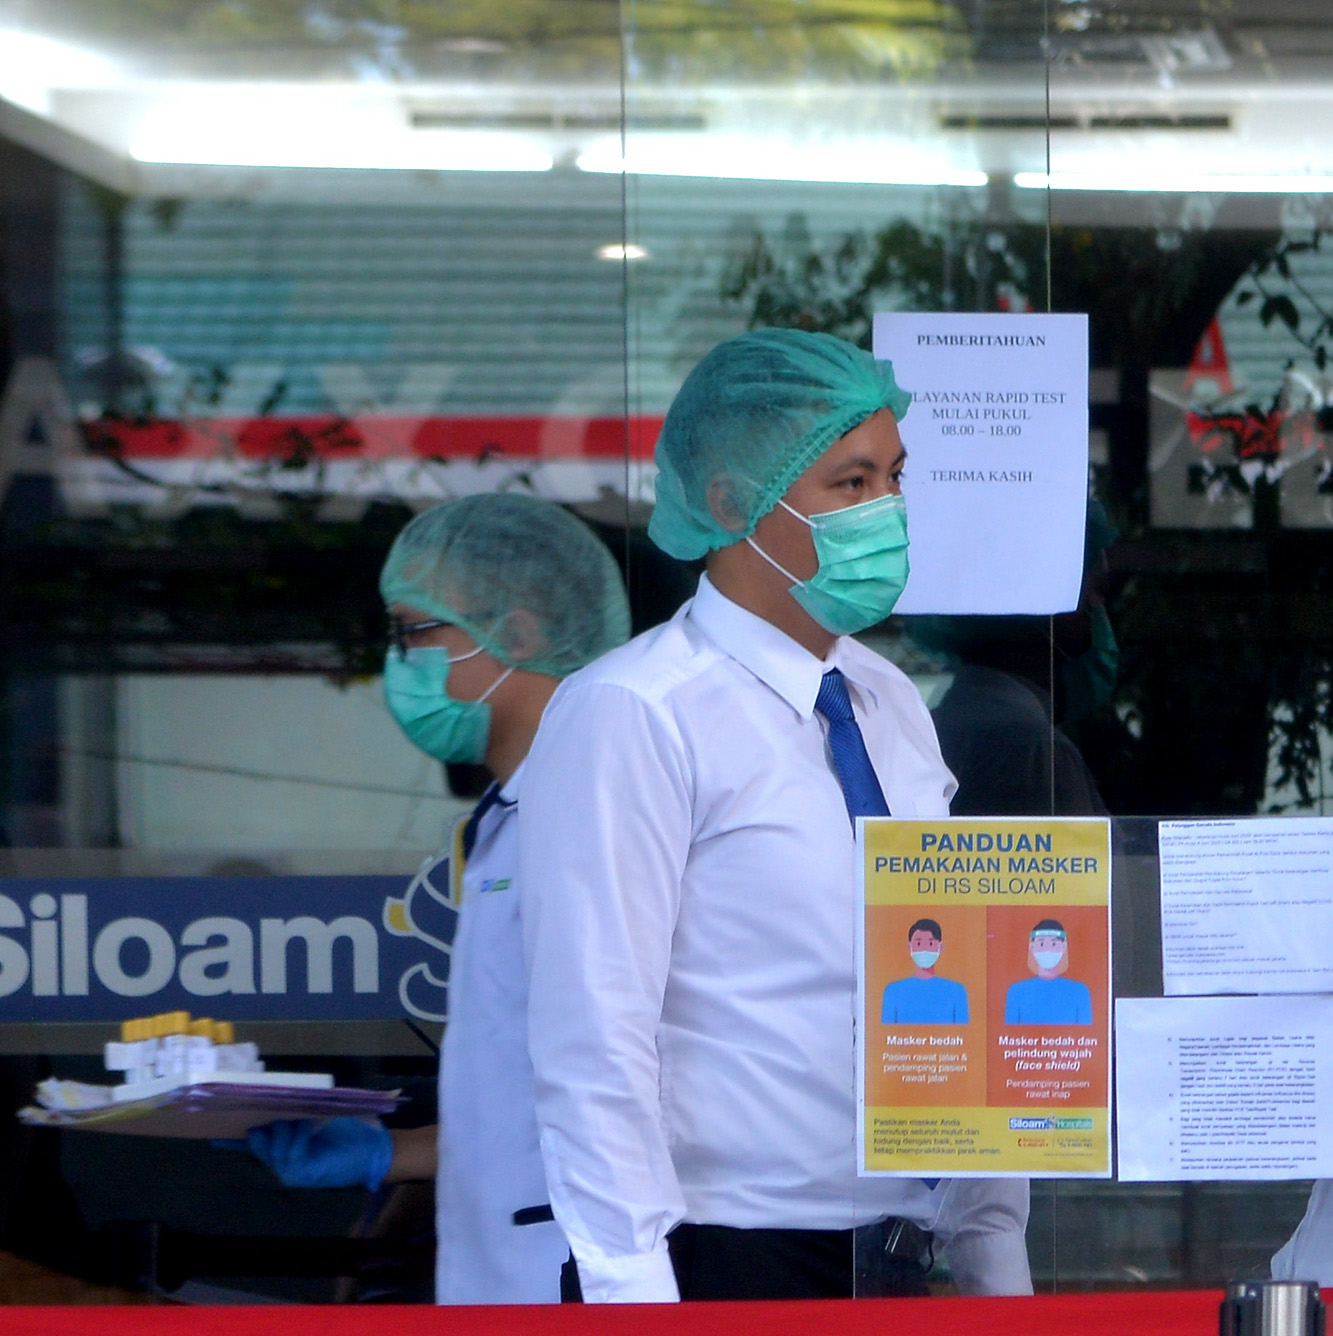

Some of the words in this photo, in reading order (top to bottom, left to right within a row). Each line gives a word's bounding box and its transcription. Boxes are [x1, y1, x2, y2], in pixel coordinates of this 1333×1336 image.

[917, 334, 1047, 347] PEMBERITAHUAN
[912, 391, 982, 404] LAYANAN
[985, 391, 1029, 404] RAPID
[1032, 393, 1067, 404] TEST
[932, 408, 980, 420] MULAI
[983, 409, 1031, 420] PUKUL
[941, 425, 975, 436] 08.00
[990, 425, 1022, 436] 18.00
[930, 470, 986, 482] TERIMA
[989, 470, 1033, 482] KASIH
[921, 833, 1052, 852] PANDUAN
[875, 857, 1001, 874] PEMAKAIAN
[1008, 857, 1098, 873] MASKER
[917, 878, 936, 894] DI
[944, 878, 971, 894] RS
[978, 878, 1056, 894] SILOAM
[886, 1035, 927, 1045] Masker
[929, 1035, 963, 1045] bedah
[998, 1036, 1039, 1046] Masker
[1041, 1036, 1074, 1046] bedah
[1077, 1036, 1097, 1046] dan
[1004, 1048, 1057, 1059] pelindung
[1060, 1048, 1092, 1059] wajah
[1015, 1060, 1042, 1071] (face
[1045, 1060, 1080, 1071] shield)
[1006, 1079, 1060, 1089] Pendamping
